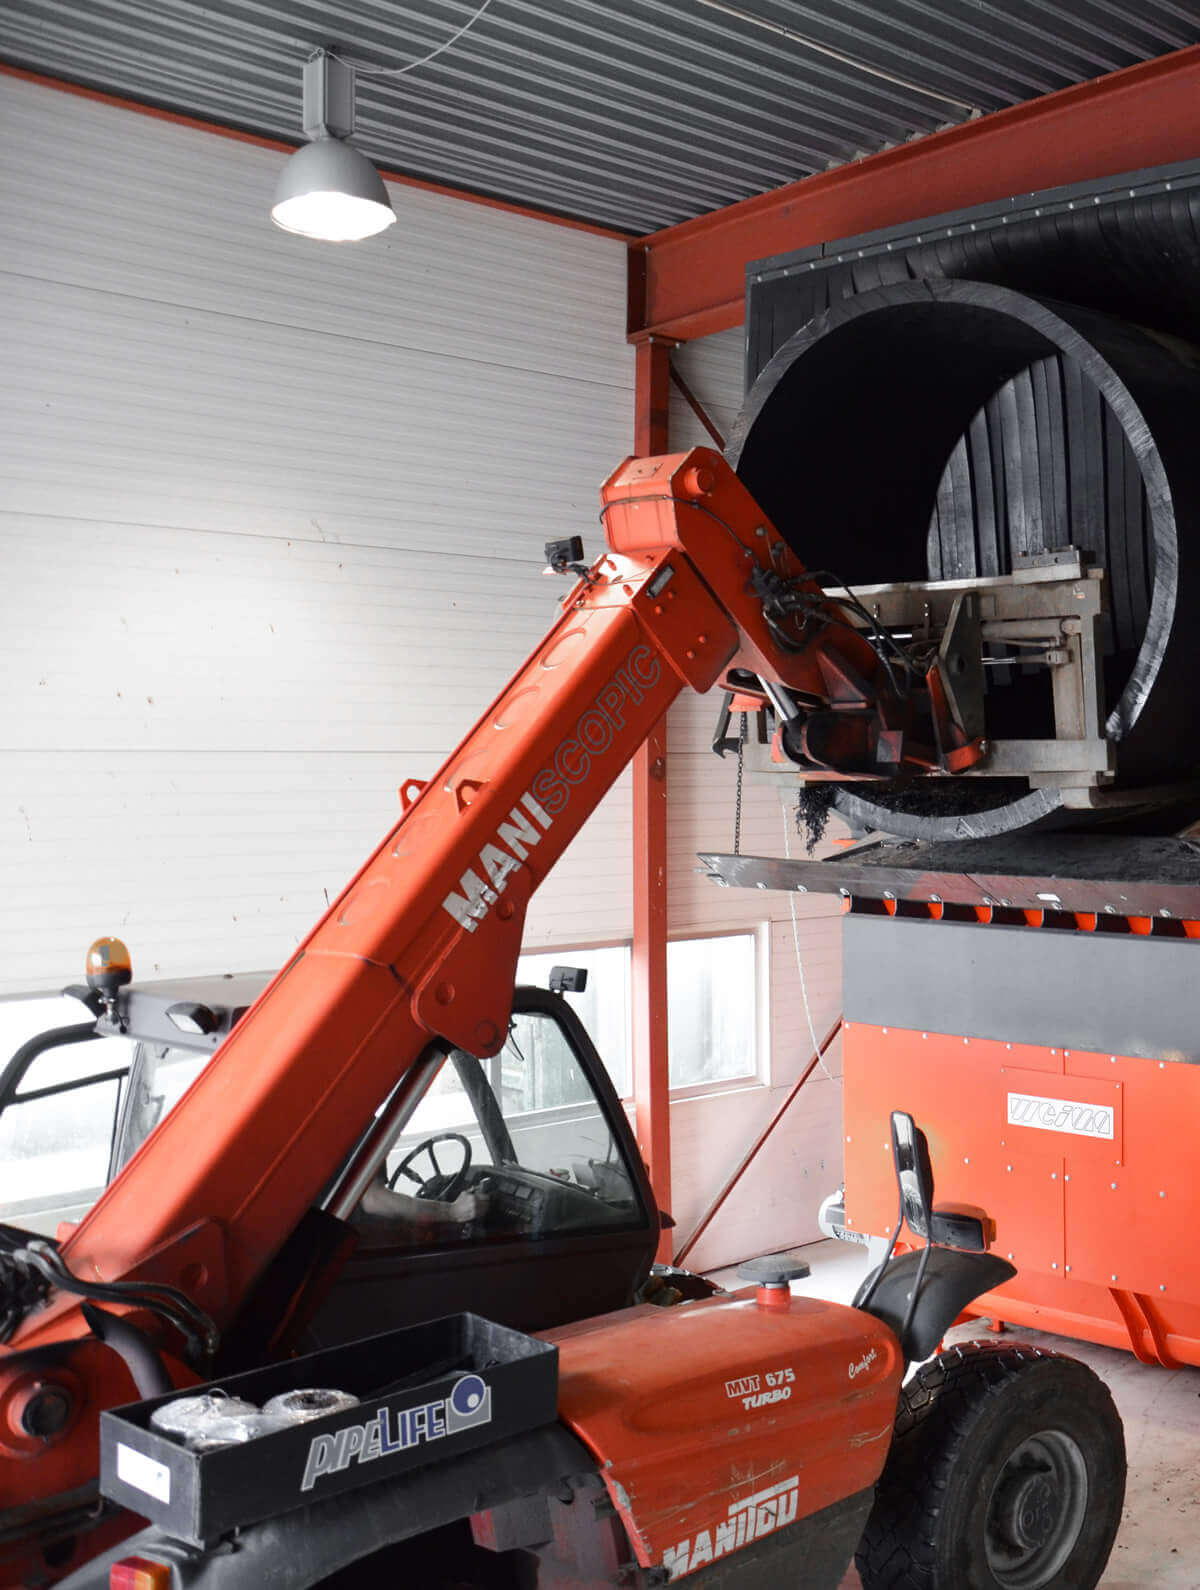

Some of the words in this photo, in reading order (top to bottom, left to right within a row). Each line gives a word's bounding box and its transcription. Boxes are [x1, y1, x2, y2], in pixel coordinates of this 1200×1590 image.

[442, 645, 661, 933] MANISCOPIC
[765, 1368, 796, 1387] 675
[848, 1347, 878, 1379] Comfort
[742, 1386, 791, 1411] TURBO
[662, 1475, 799, 1581] MANITOU
